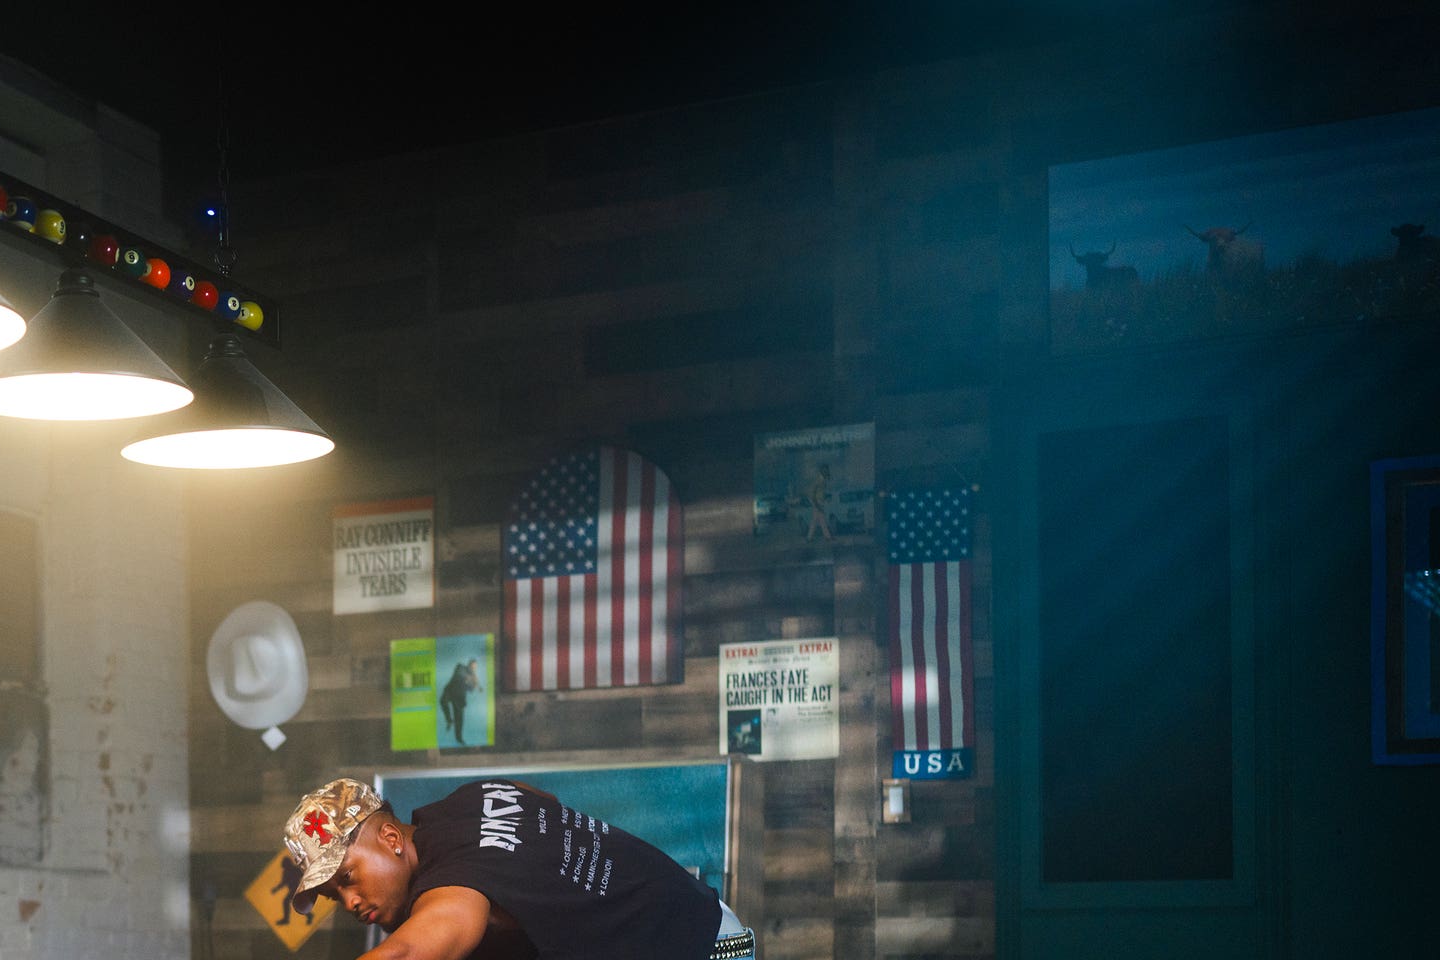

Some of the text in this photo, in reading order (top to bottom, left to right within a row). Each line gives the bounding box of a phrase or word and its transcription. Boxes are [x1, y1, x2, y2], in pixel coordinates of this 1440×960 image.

[364, 519, 432, 546] CONNIFF
[346, 547, 422, 576] INVISIBLE
[359, 573, 408, 598] TEARS
[725, 647, 759, 659] EXTRA!
[799, 642, 833, 654] EXTRA!
[726, 669, 808, 689] FRANCES FAYE
[726, 684, 833, 706] CAUGHT IN THE ACT
[903, 752, 964, 775] USA
